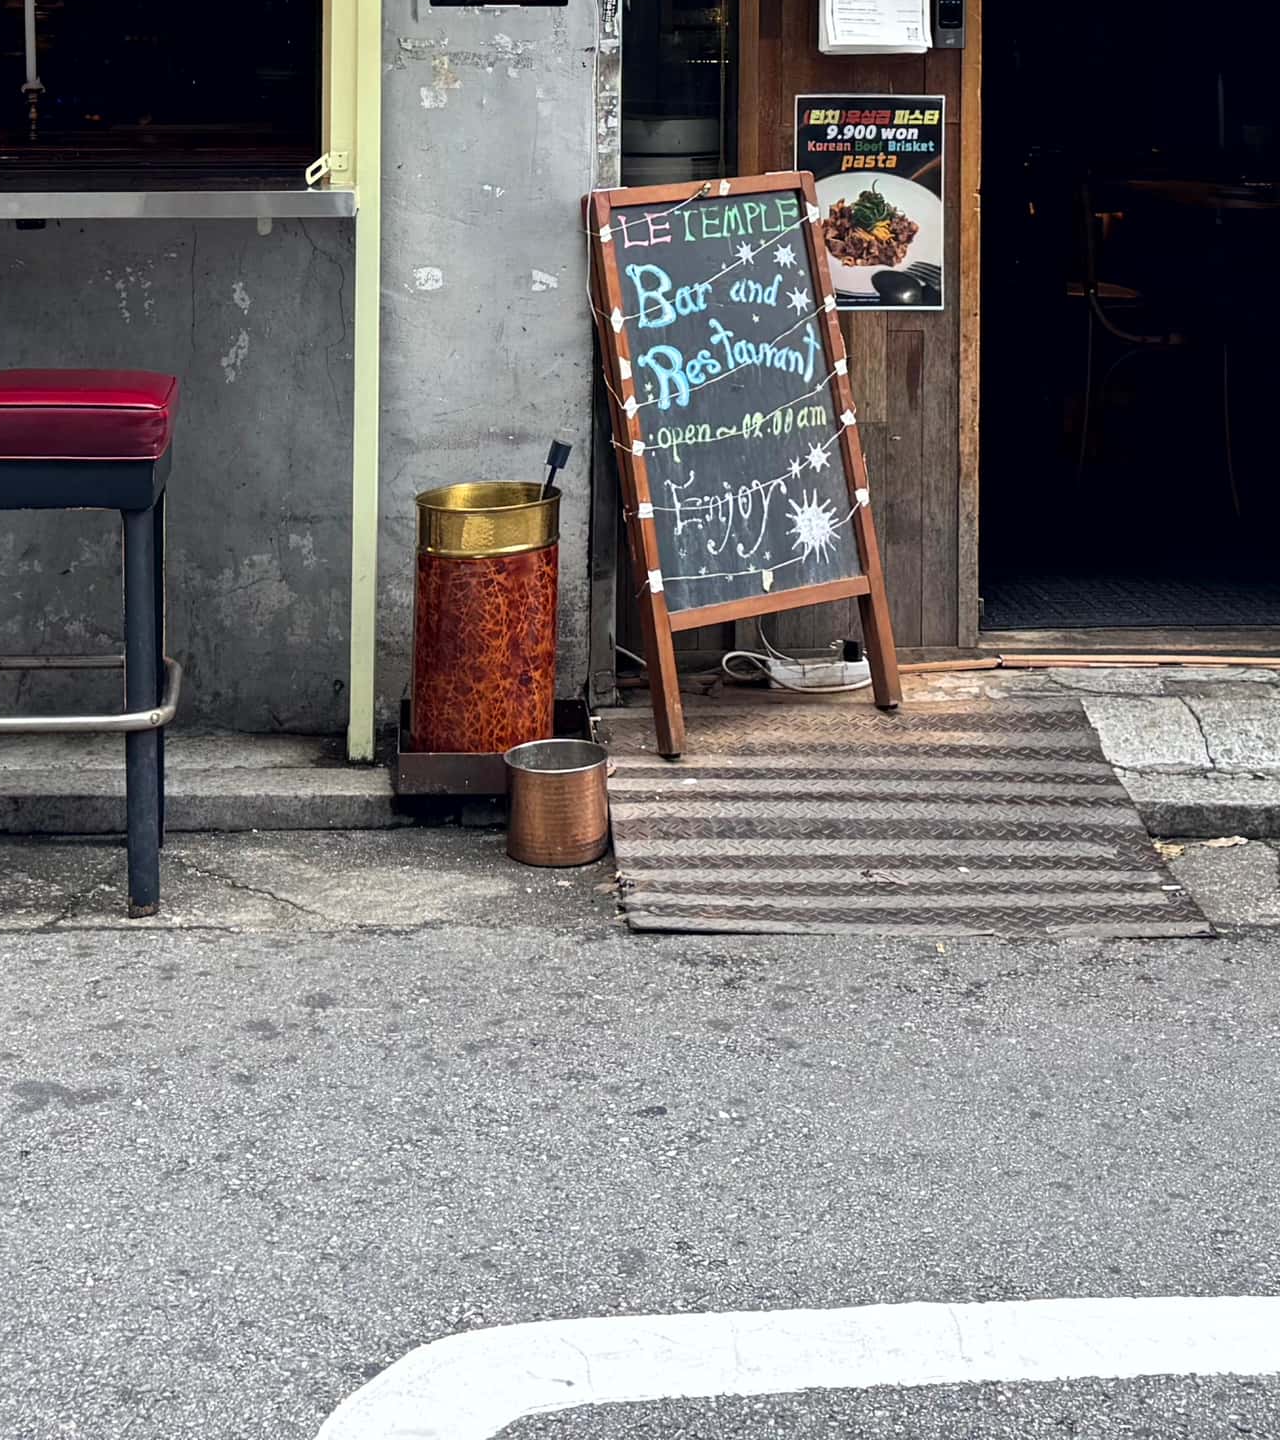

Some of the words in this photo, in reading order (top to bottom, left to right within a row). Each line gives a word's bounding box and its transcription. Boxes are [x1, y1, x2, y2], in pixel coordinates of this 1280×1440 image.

[826, 125, 877, 140] 9.900
[881, 127, 919, 140] won
[893, 109, 940, 125] 파스타
[807, 140, 851, 152] Korean
[888, 140, 935, 152] Brisket
[841, 151, 898, 171] pasta
[617, 212, 672, 248] LE
[674, 198, 801, 242] TEMPLE
[625, 264, 713, 329] Bar
[729, 273, 783, 307] and
[637, 318, 821, 410] Restaurant
[664, 469, 788, 558] Enjoy
